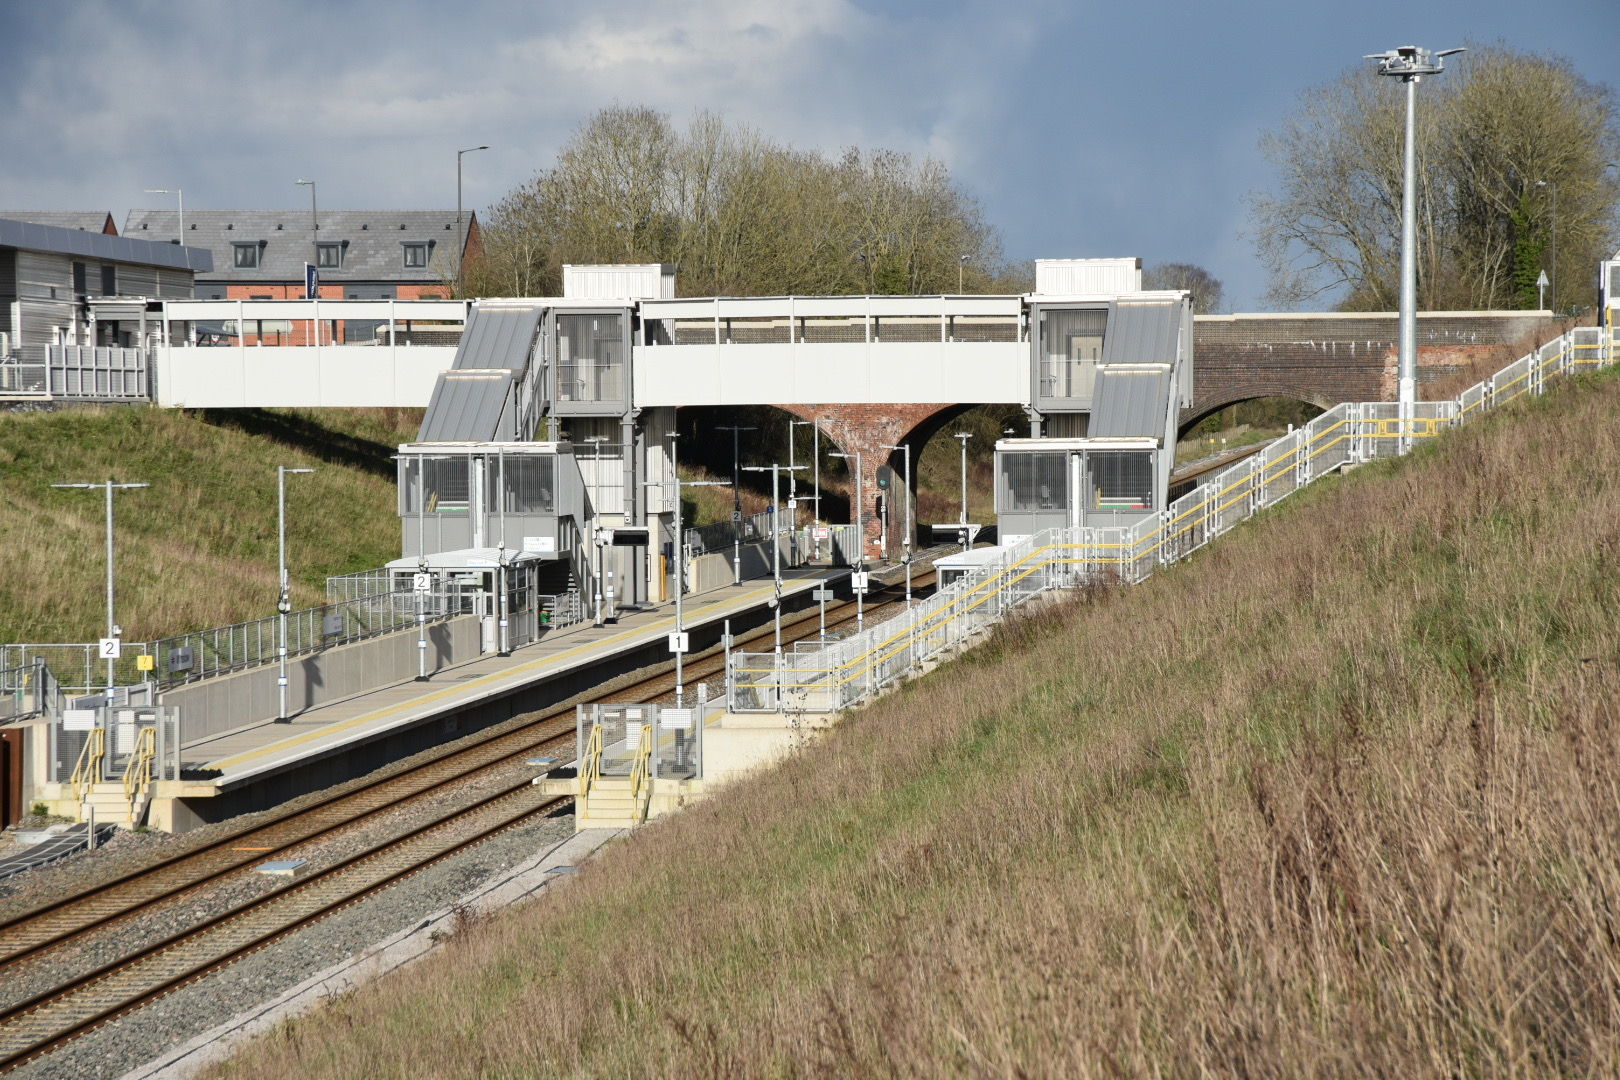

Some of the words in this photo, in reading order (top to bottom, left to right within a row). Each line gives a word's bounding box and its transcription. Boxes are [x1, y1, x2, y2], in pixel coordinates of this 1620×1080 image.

[734, 512, 739, 520] 2
[418, 576, 425, 587] 2
[857, 575, 861, 585] 1
[676, 636, 680, 648] 1
[105, 642, 114, 655] 2
